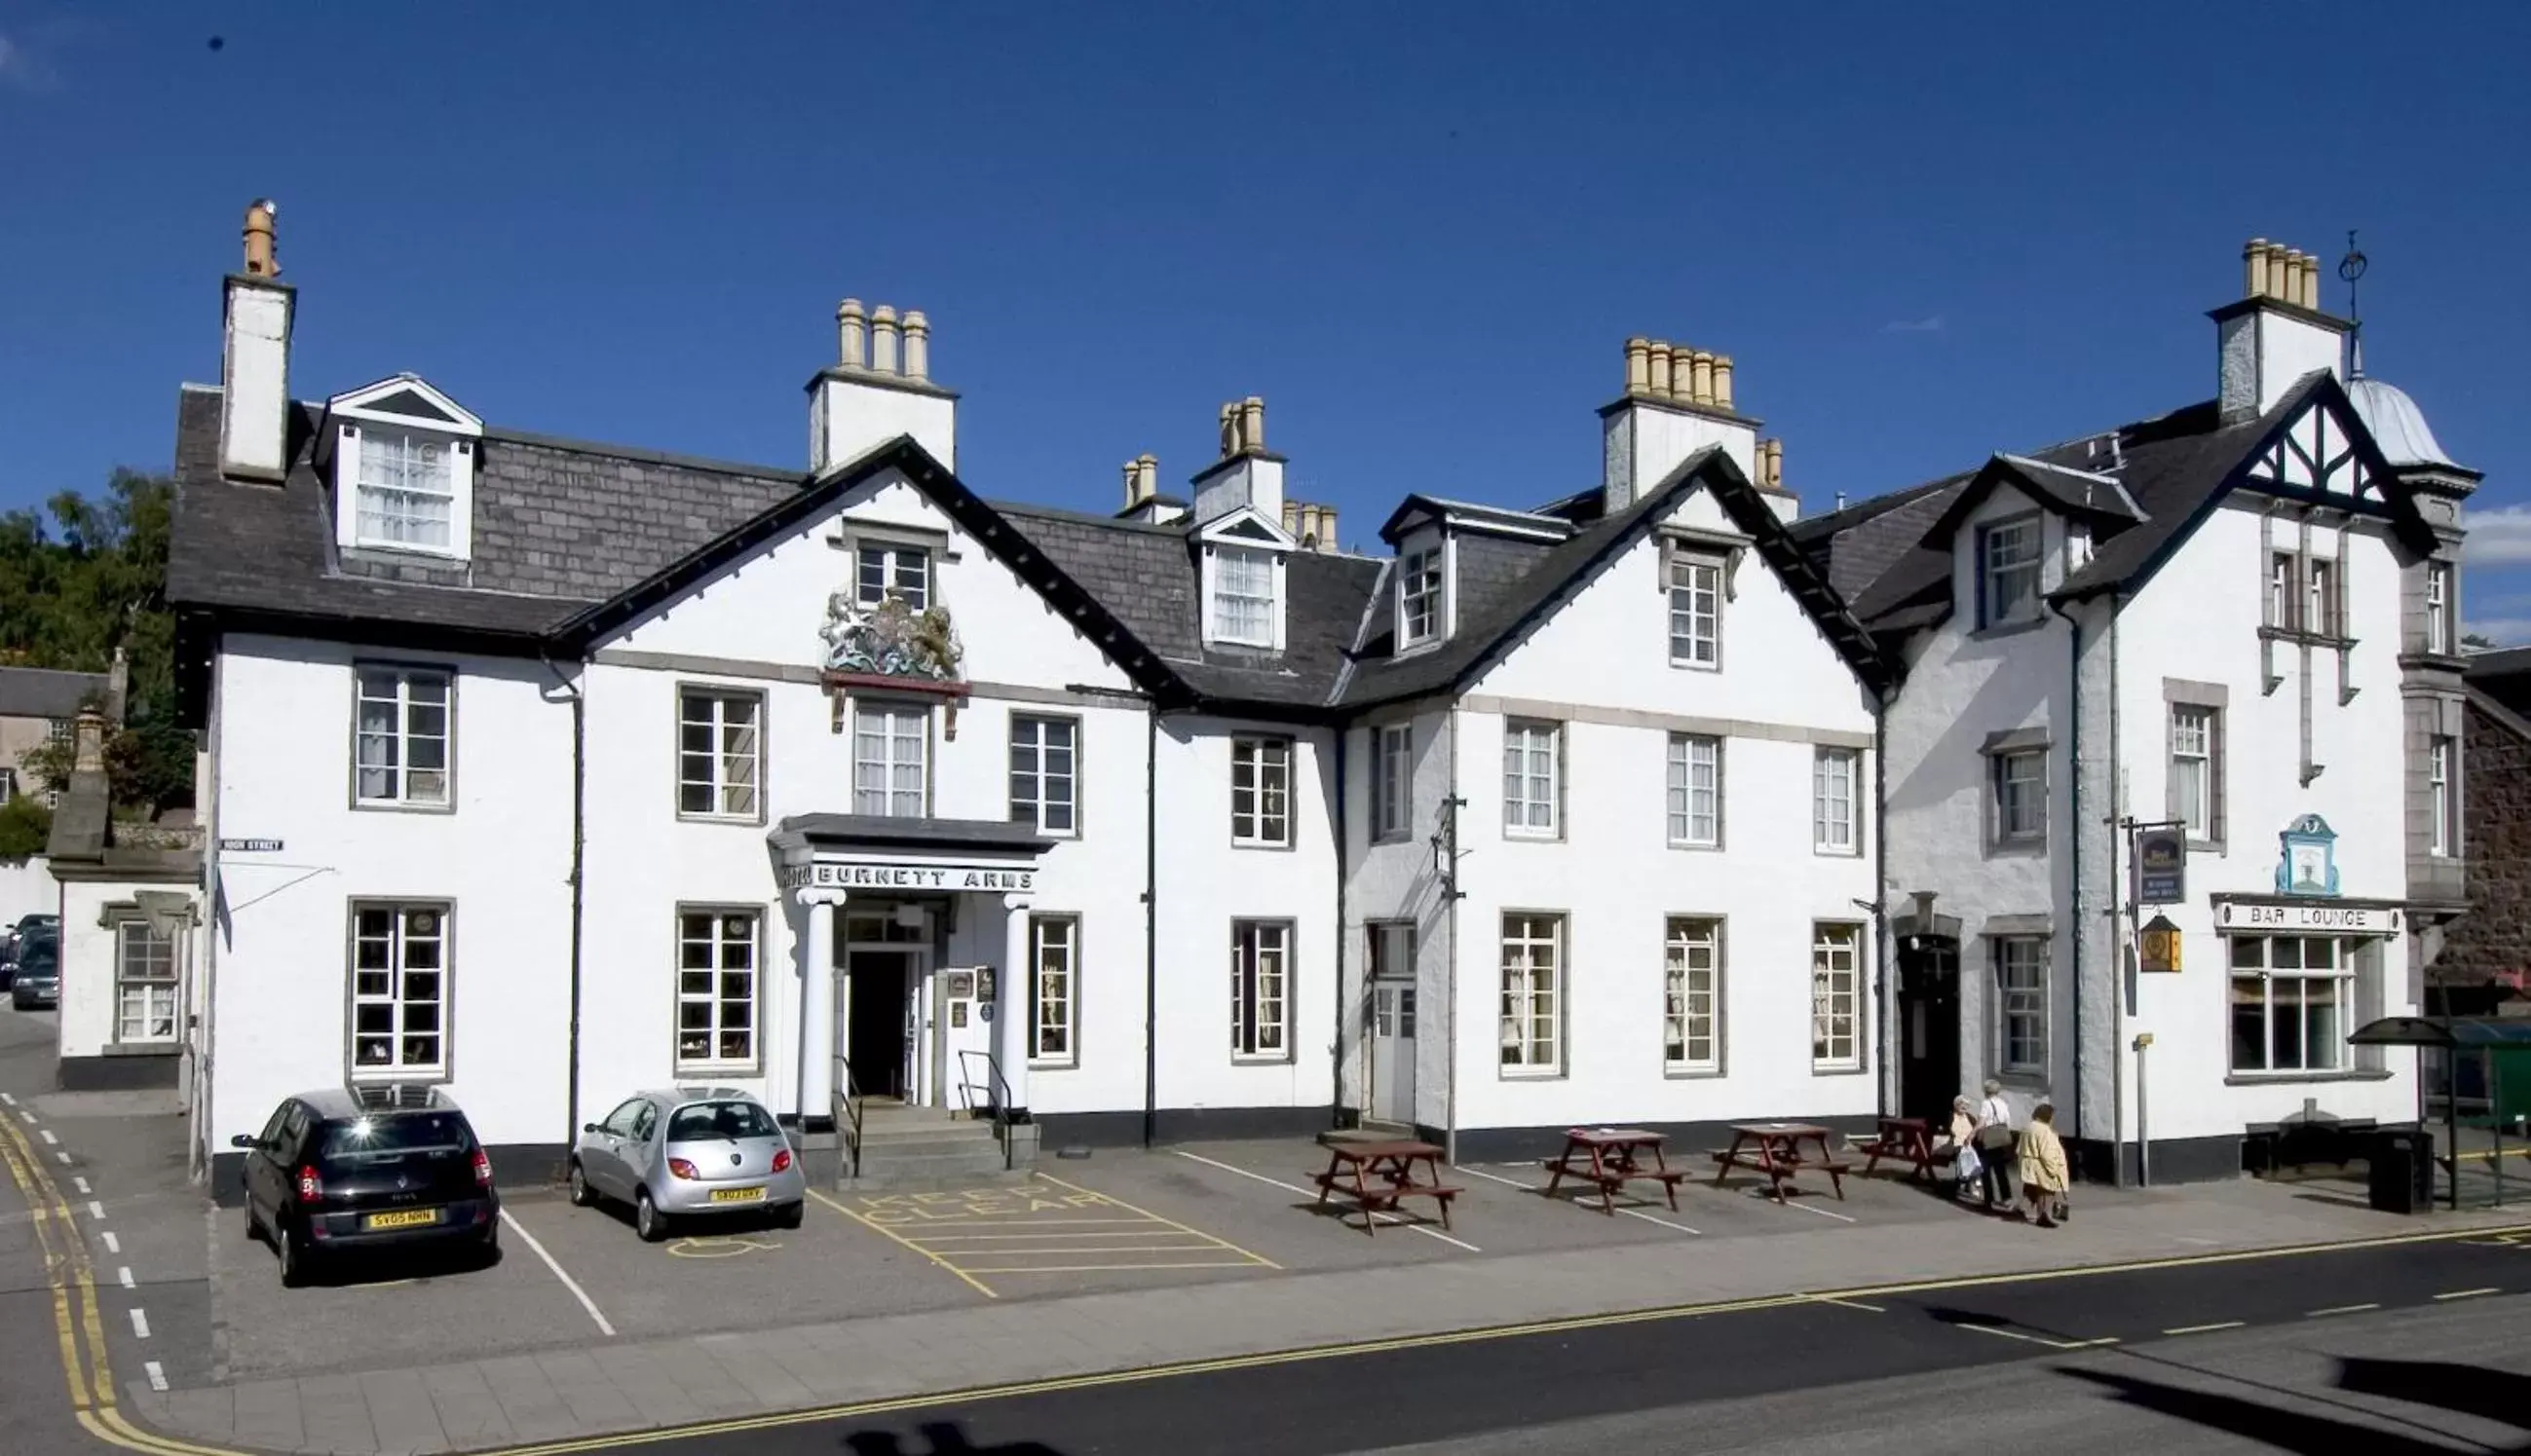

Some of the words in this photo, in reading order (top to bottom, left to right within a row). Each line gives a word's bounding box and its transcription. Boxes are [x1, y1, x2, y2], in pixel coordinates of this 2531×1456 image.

[247, 840, 280, 850] STREET
[817, 867, 946, 886] BURNETT
[963, 872, 1034, 888] ARMS
[2250, 908, 2285, 924] BAR
[2300, 909, 2367, 926] LOUNGE
[858, 1186, 1048, 1208] KEEP
[864, 1193, 1112, 1223] CLEAR
